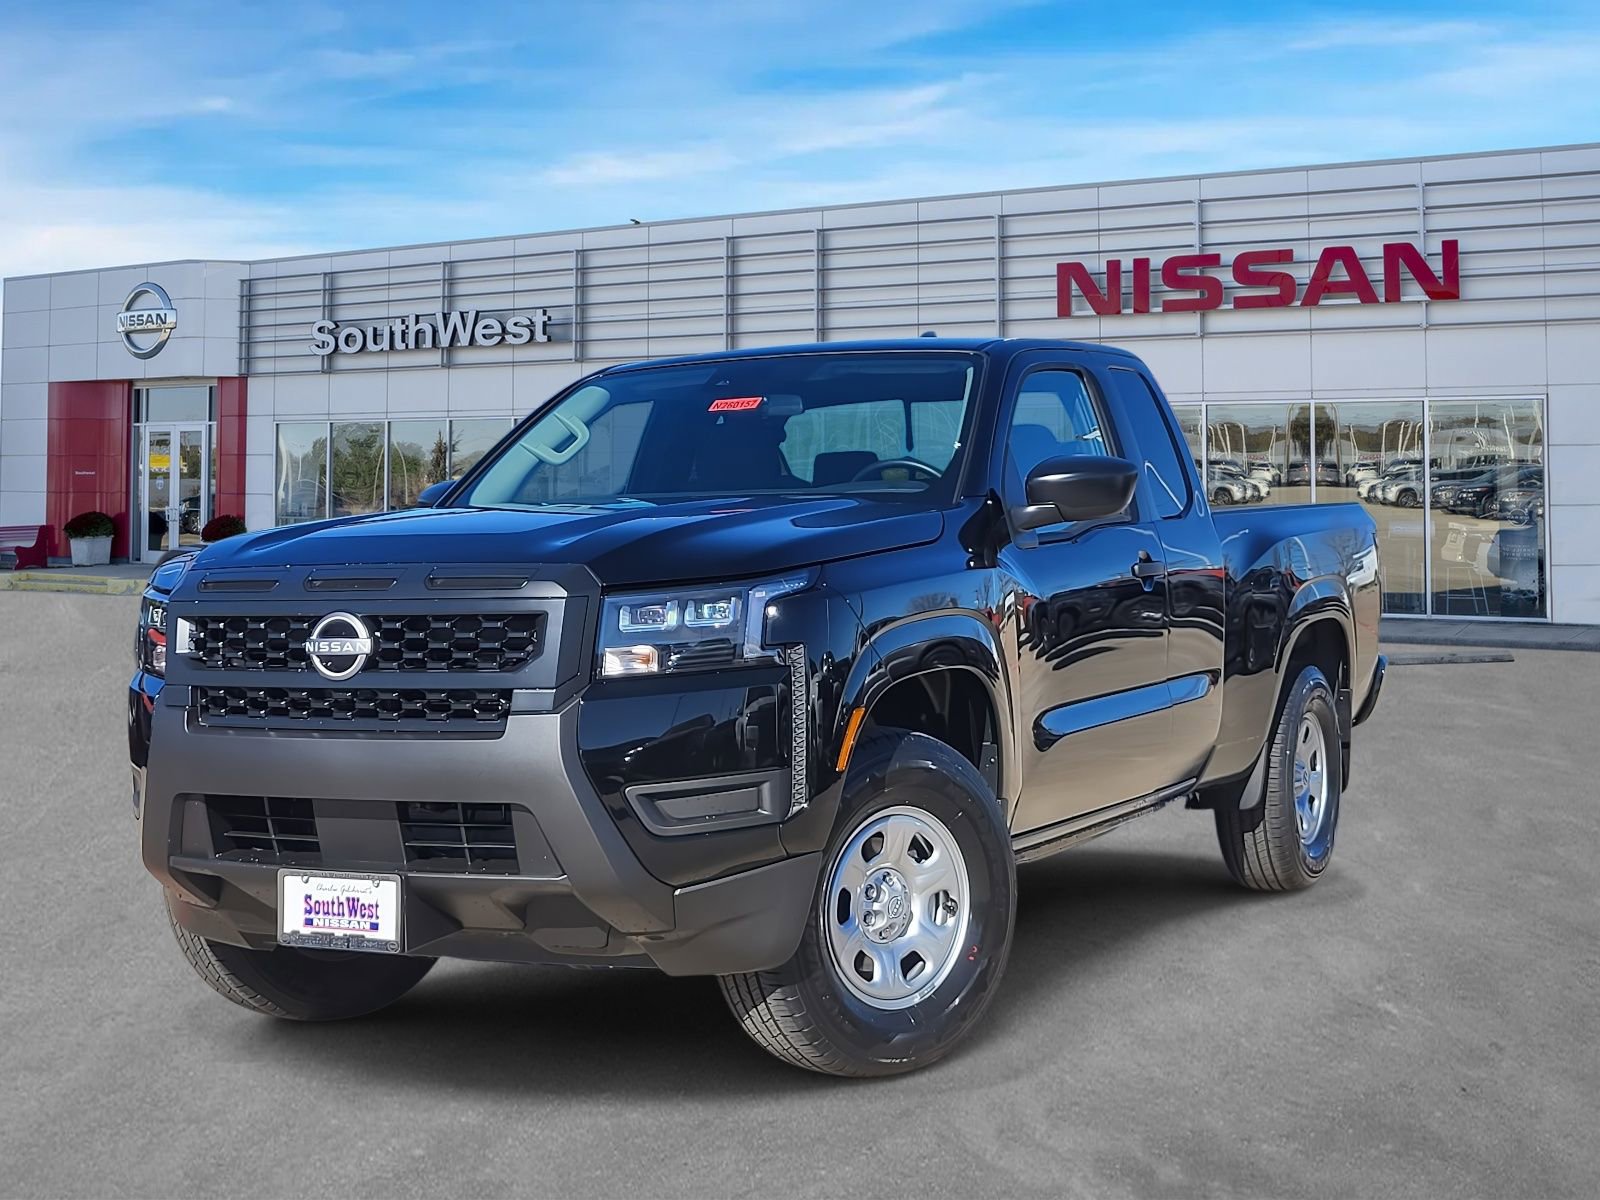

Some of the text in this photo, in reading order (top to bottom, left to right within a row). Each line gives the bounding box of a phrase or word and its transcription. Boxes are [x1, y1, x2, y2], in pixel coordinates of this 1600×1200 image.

[1056, 239, 1460, 318] NISSAN
[119, 312, 167, 328] NISSAN
[309, 308, 551, 356] SouthWest
[712, 399, 759, 410] N260157
[305, 641, 369, 653] NISSAN
[303, 893, 380, 920] SouthWest
[312, 917, 371, 930] NISSAN
